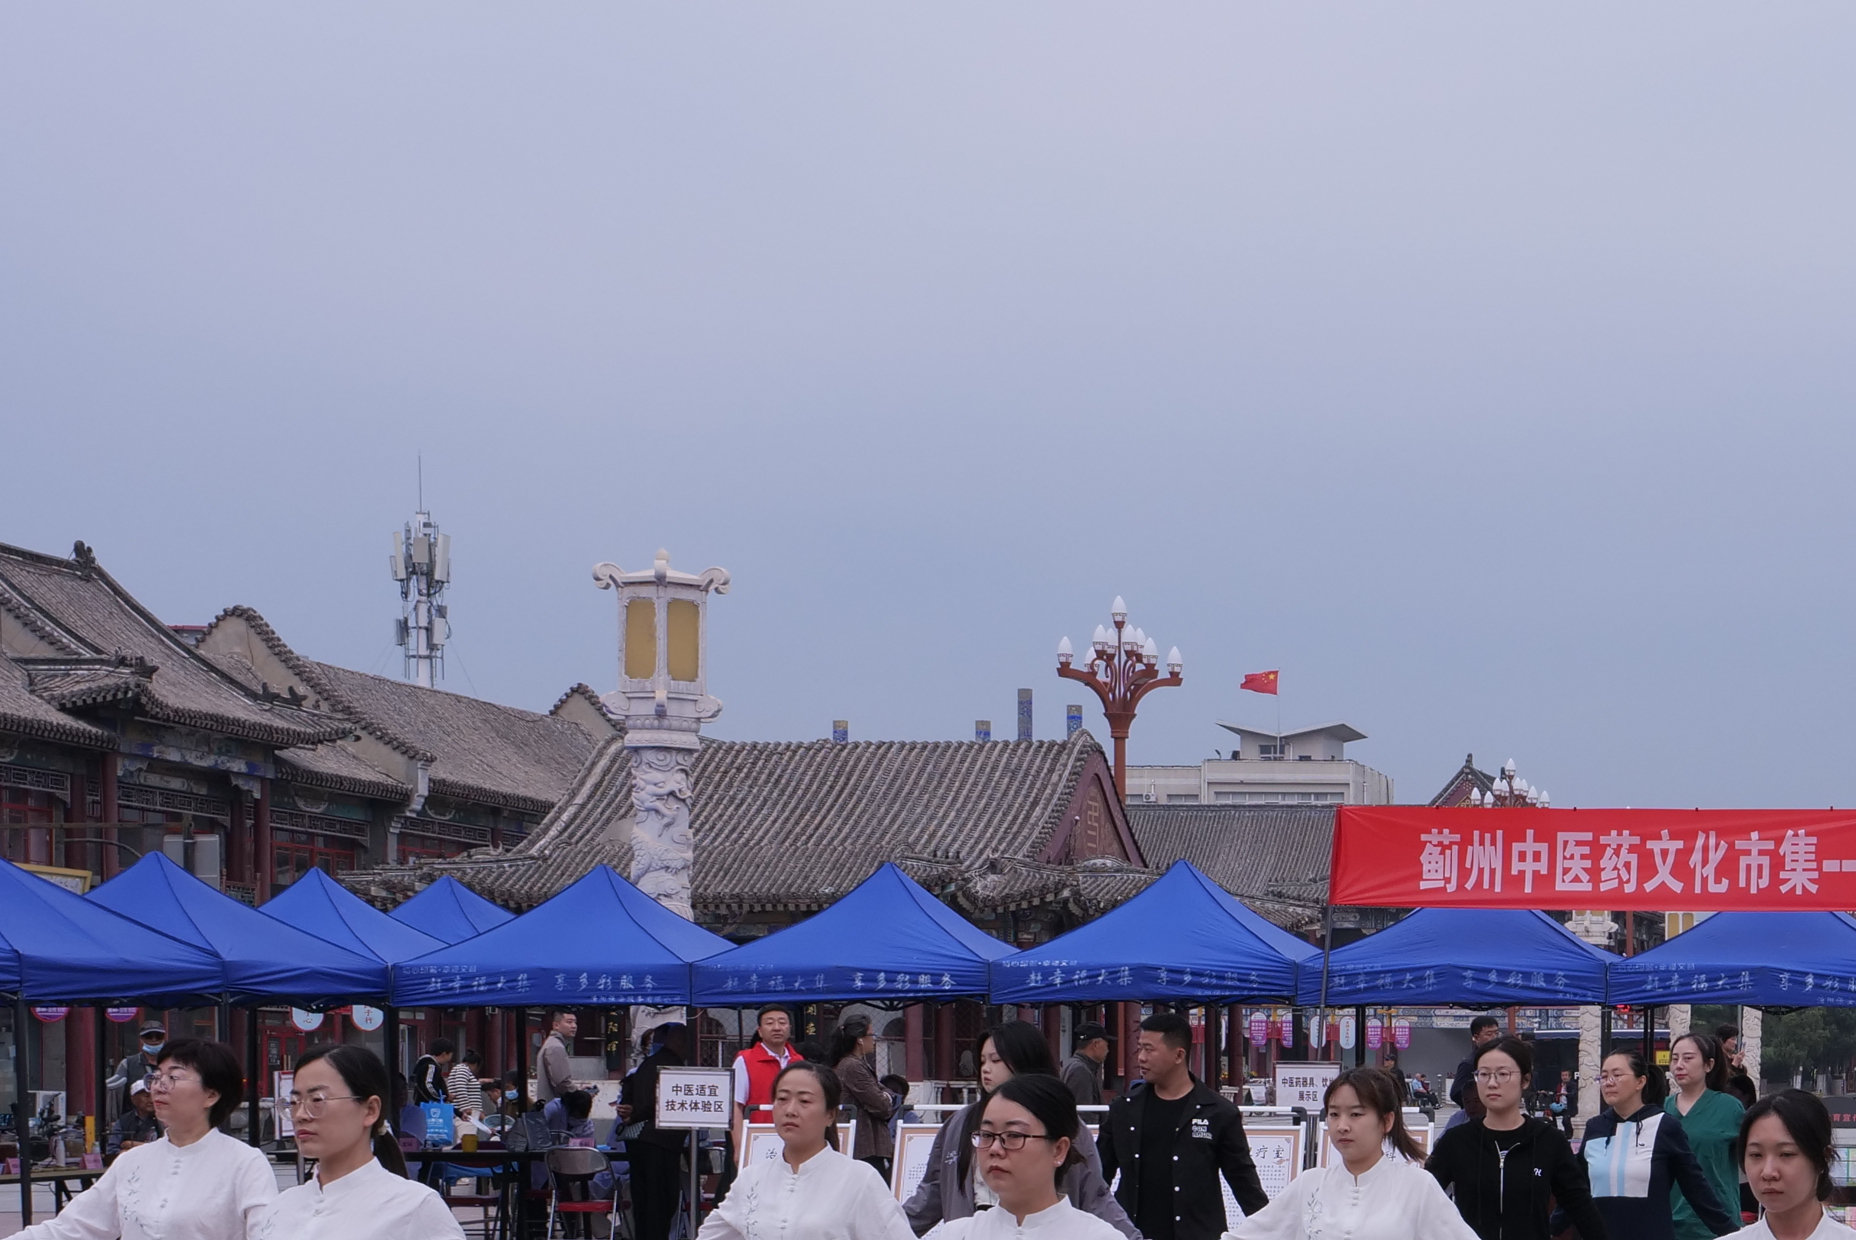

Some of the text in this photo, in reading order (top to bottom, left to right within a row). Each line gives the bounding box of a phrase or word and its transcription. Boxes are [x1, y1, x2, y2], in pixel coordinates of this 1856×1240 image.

[427, 972, 659, 994] 赶幸福大集 享多彩服务
[722, 971, 957, 992] 赶幸福大集 享多彩服务
[1026, 966, 1263, 988] 赶幸福大集 享多彩服务
[1329, 969, 1570, 991] 赶幸福大集 享多彩服务
[1643, 970, 1754, 992] 赶幸福大集
[671, 1083, 719, 1097] 中医适宜
[1298, 1091, 1318, 1102] 展示区
[665, 1099, 724, 1113] 技术体验区
[1192, 1118, 1210, 1126] FILA
[1255, 1145, 1284, 1159] 疗室
